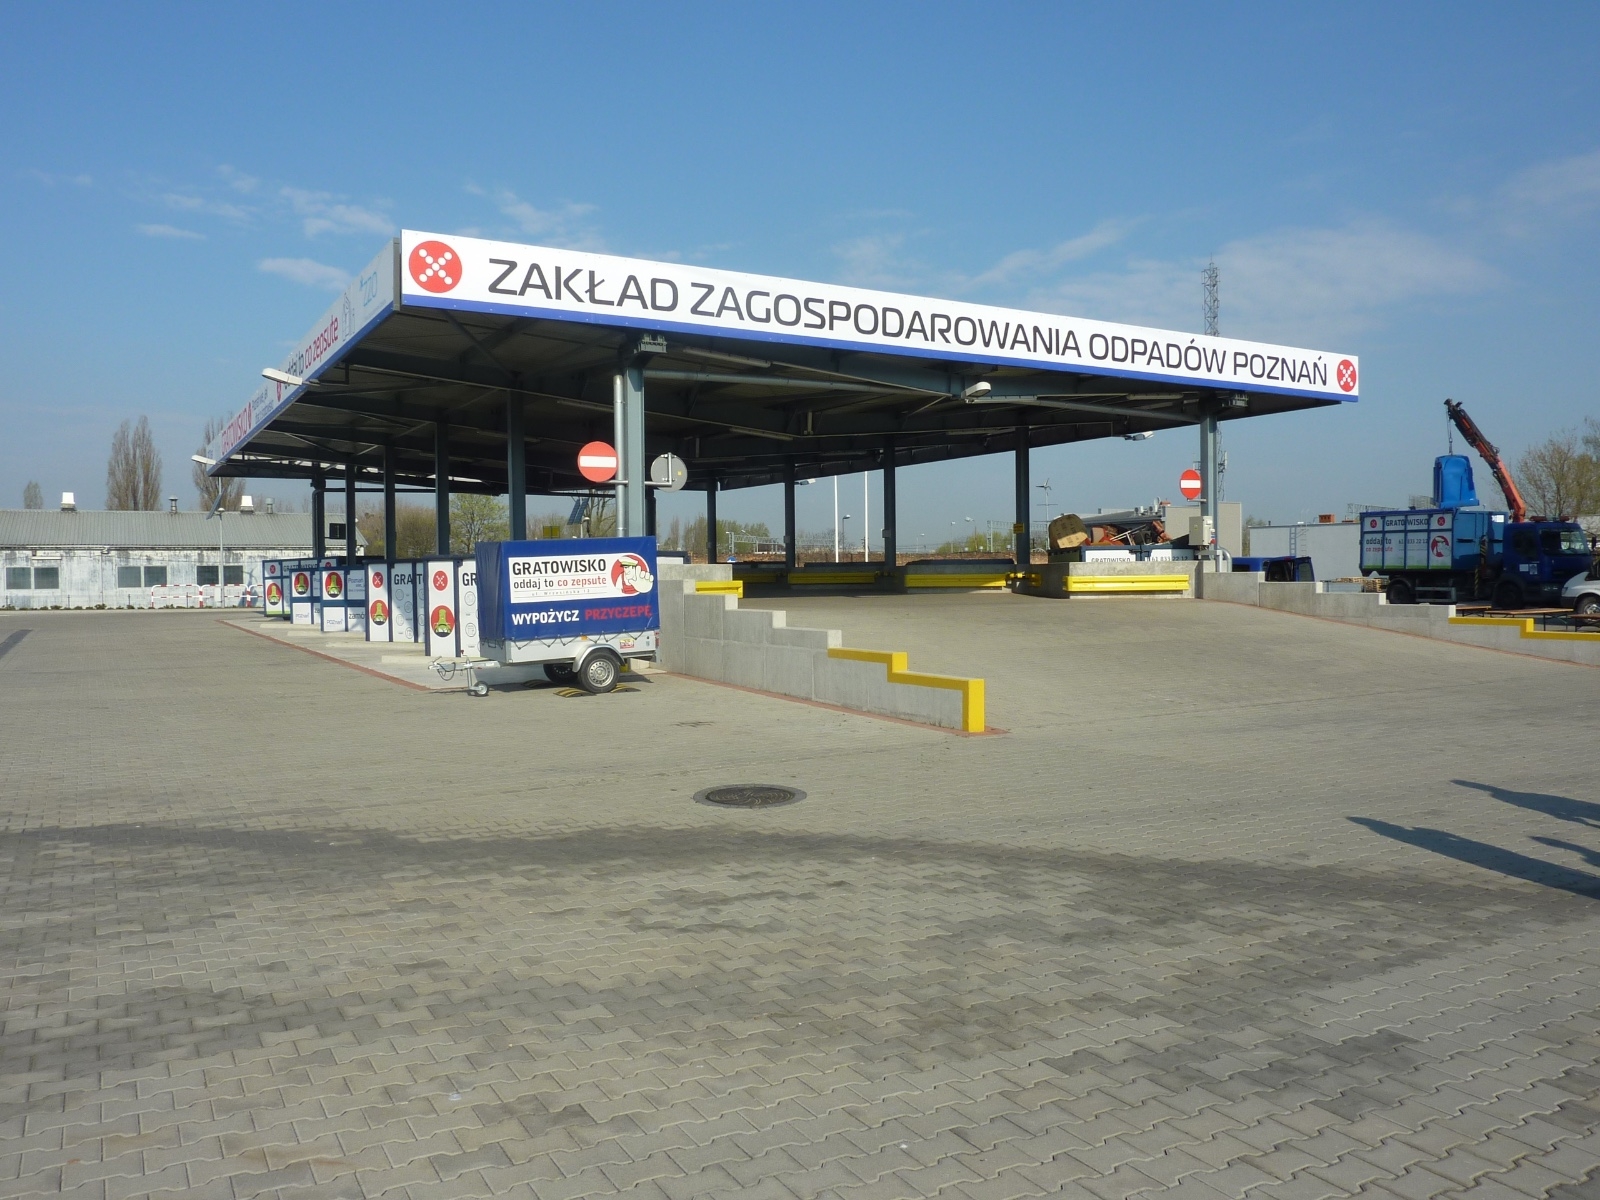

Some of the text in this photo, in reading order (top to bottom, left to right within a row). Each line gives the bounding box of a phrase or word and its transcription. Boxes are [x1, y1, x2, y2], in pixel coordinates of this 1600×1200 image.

[488, 257, 1328, 387] ZAKŁAD ZAGOSPODAROWANIA ODPADÓW POZNAŃ
[512, 558, 607, 576] GRATOWISKO
[513, 575, 607, 590] oddaj to co zepsute
[511, 605, 653, 625] WYPOŻYCZ PRZYCZEPĘ
